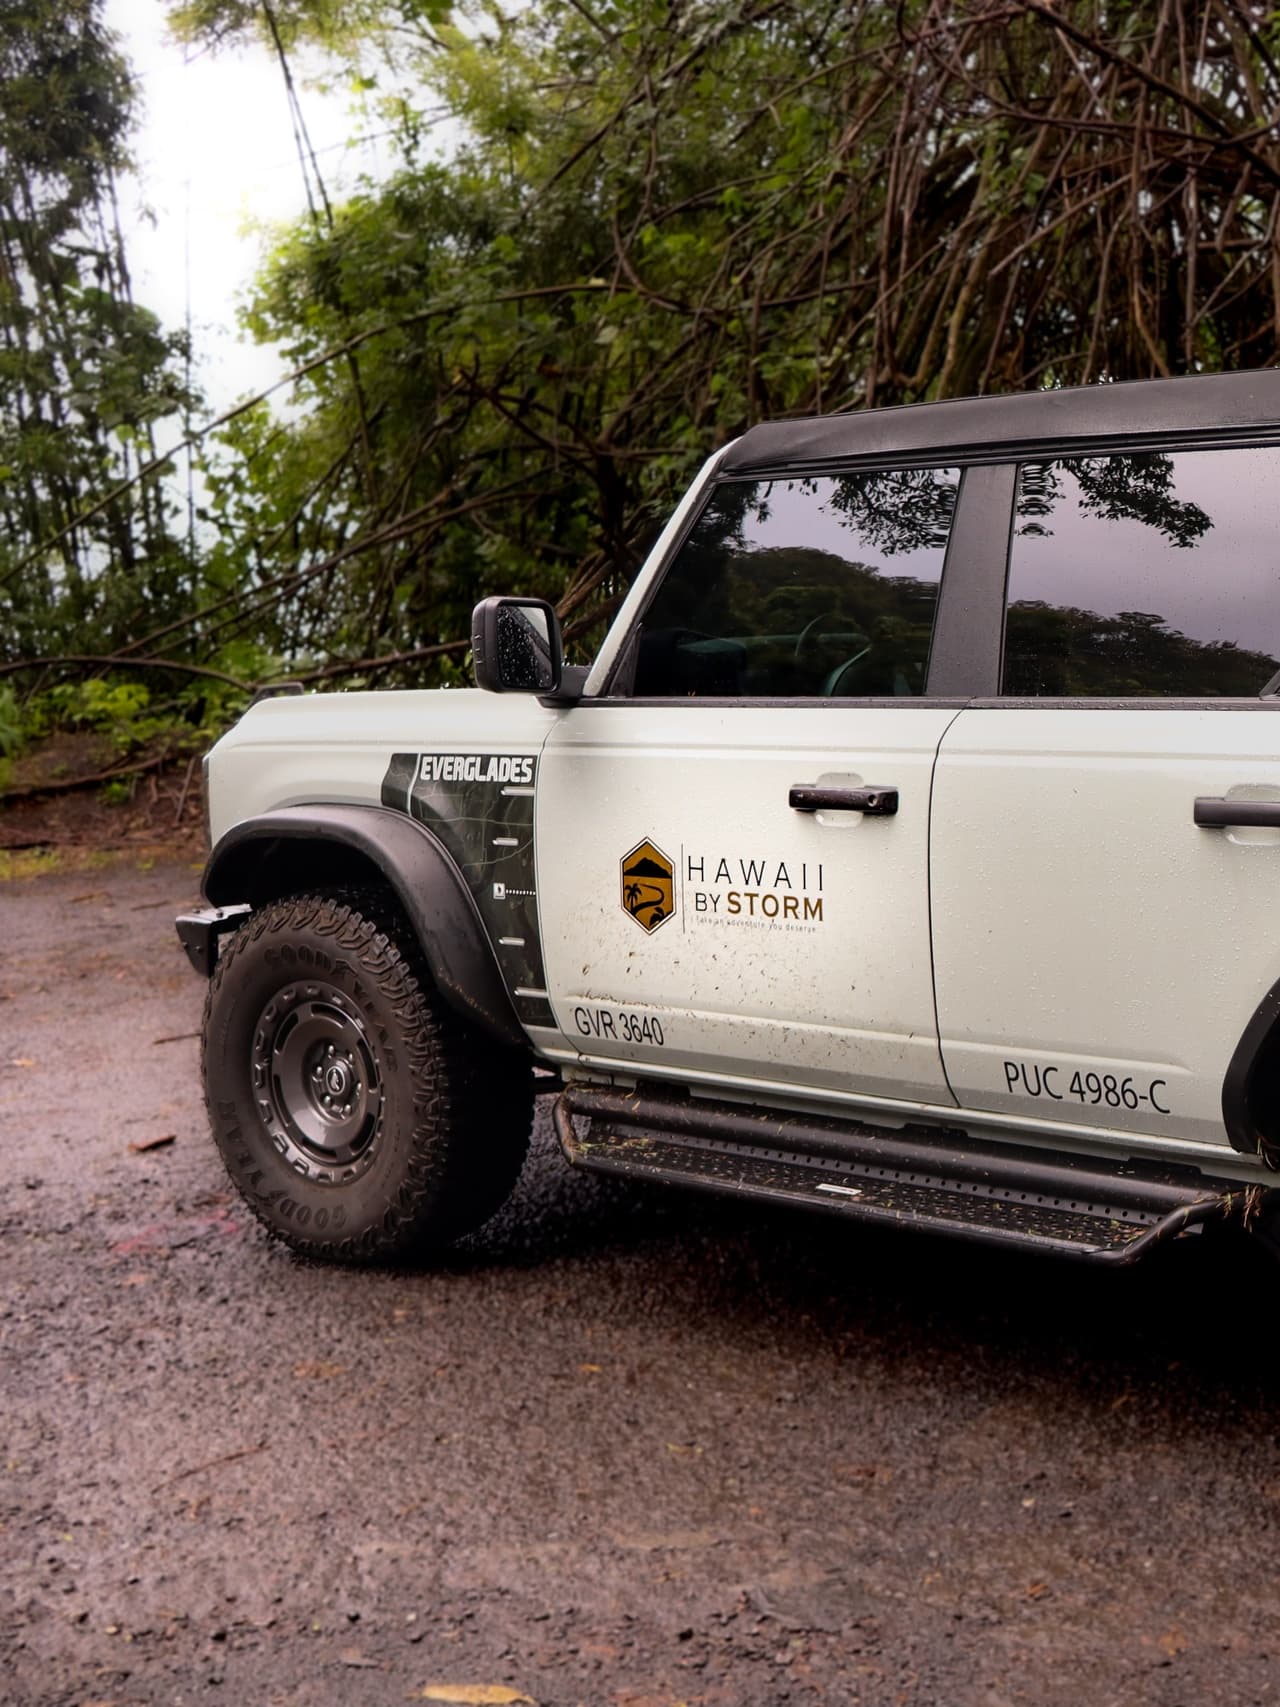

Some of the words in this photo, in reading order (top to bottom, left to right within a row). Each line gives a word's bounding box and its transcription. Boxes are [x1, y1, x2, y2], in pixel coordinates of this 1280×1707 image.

[419, 756, 533, 783] EVERGLADES
[688, 855, 823, 891] HAWAII
[695, 892, 720, 912] BY
[727, 891, 823, 921] STORM
[574, 1007, 618, 1039] GVR
[619, 1013, 664, 1046] 3640
[1003, 1061, 1063, 1100] PUC
[1069, 1071, 1171, 1114] 4986-C
